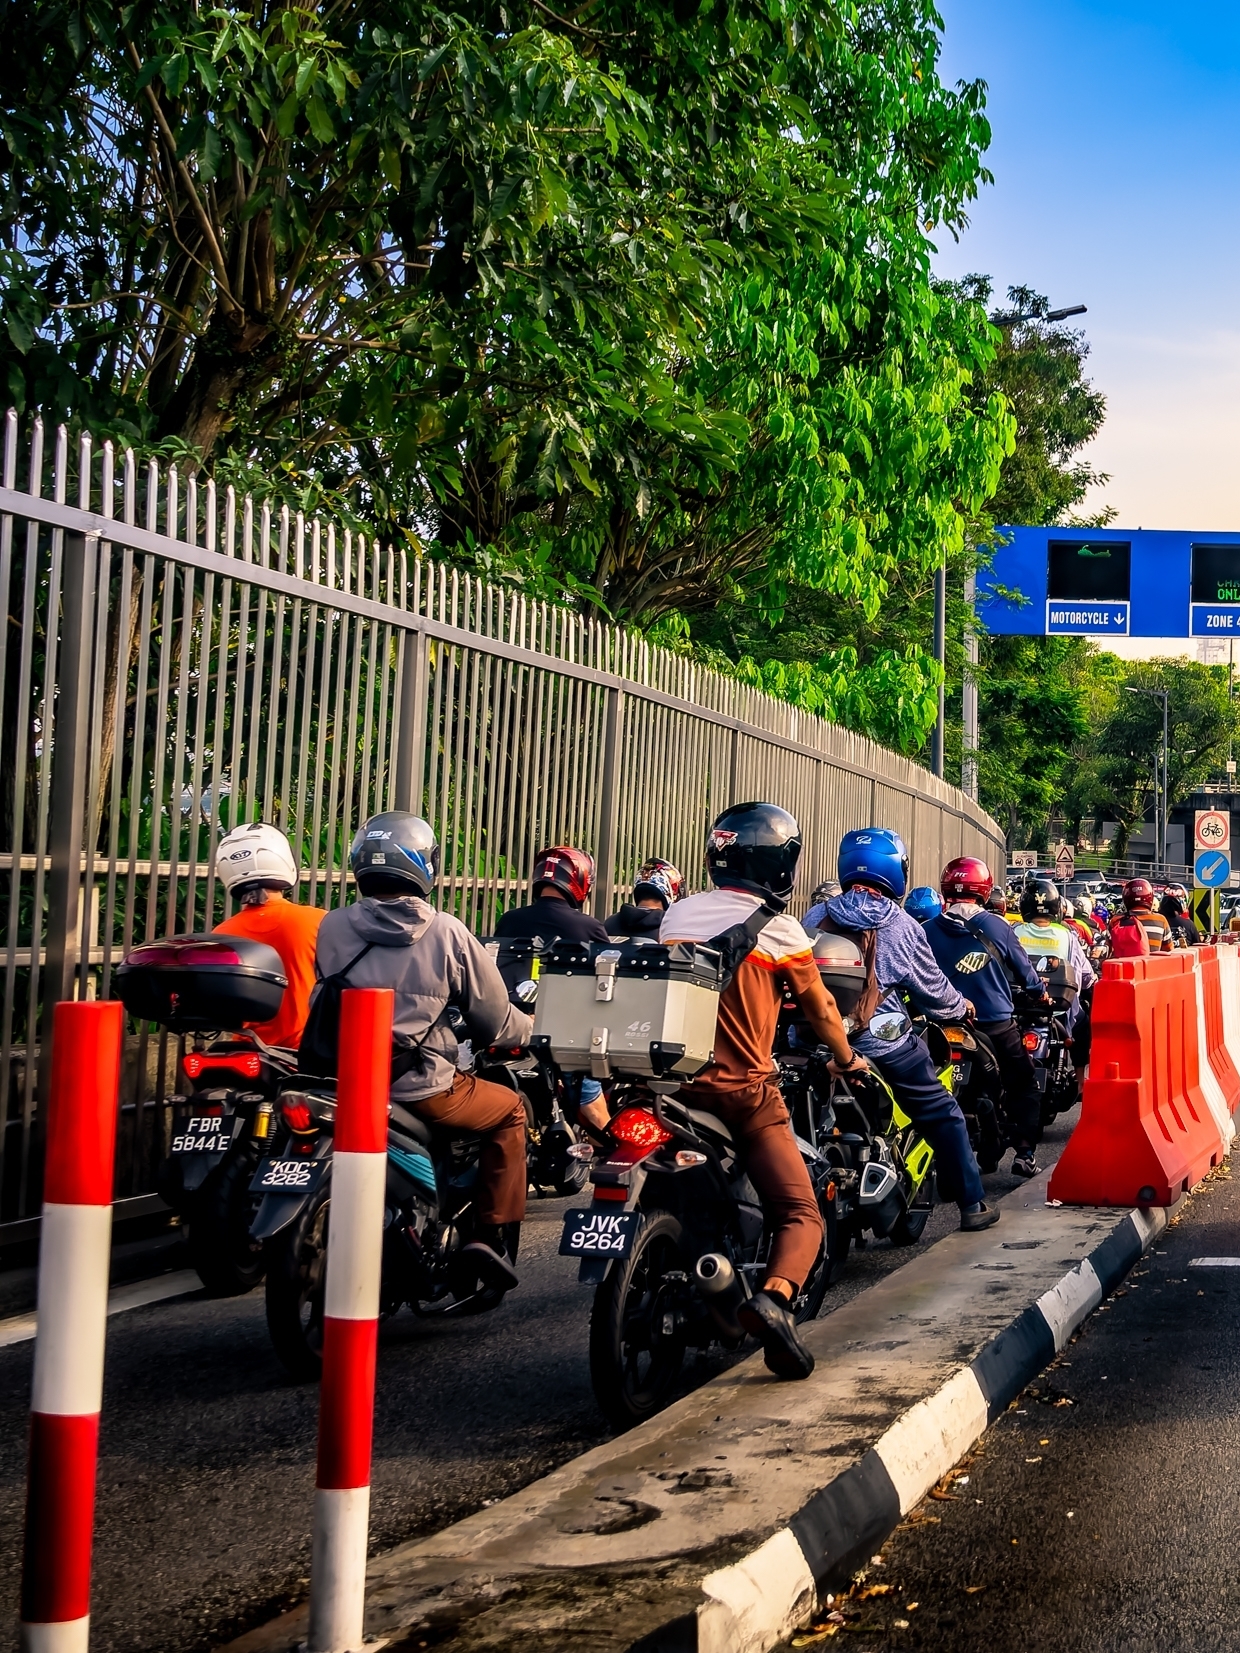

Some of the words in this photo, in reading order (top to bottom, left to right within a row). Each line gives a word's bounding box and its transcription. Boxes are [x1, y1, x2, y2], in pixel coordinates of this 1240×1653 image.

[1051, 611, 1109, 625] MOTORCYCLE
[1206, 615, 1233, 628] ZONE
[1056, 867, 1073, 875] SLOW
[627, 1020, 651, 1032] 46
[187, 1117, 222, 1132] FBR
[172, 1135, 231, 1151] 5844E
[272, 1161, 311, 1174] KDC
[261, 1173, 311, 1186] 3282
[581, 1215, 623, 1234] JVK
[570, 1232, 626, 1251] 9264
